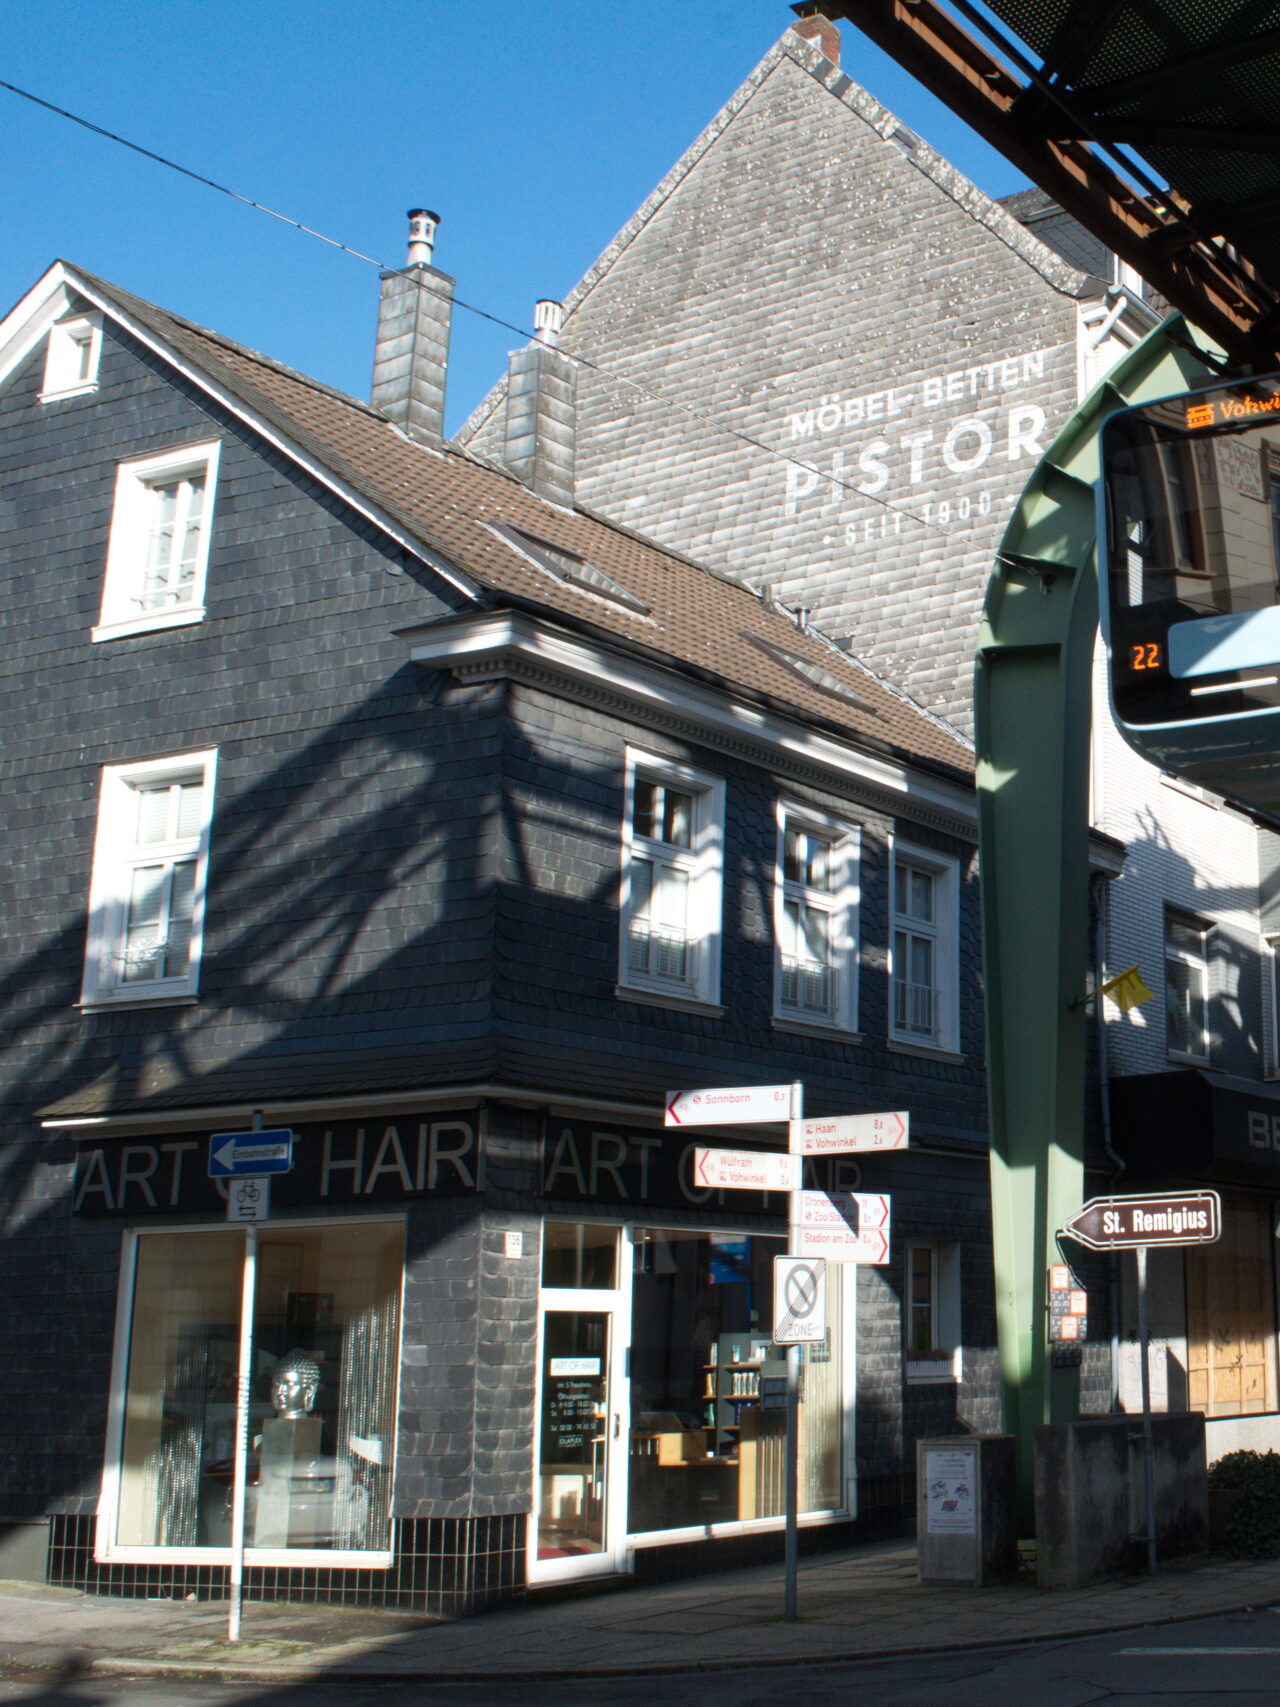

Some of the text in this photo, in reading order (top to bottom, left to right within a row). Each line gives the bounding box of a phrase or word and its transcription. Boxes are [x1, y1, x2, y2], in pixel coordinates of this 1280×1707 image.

[784, 404, 1046, 516] PISTOR
[845, 491, 992, 546] SEIT 1900
[1132, 643, 1160, 671] 22
[705, 1093, 751, 1104] Sonnborn
[815, 1124, 836, 1134] Haan
[816, 1136, 857, 1149] Vohwinkel
[75, 1141, 199, 1211] ART
[320, 1120, 476, 1197] HAIR
[544, 1128, 662, 1199] ART
[720, 1155, 752, 1168] Wülfrath
[729, 1172, 767, 1185] Vohwinkel
[805, 1196, 846, 1209] Cronenberg
[1103, 1206, 1208, 1235] St. Remigius
[804, 1233, 830, 1243] Stadion
[831, 1235, 843, 1243] am
[845, 1234, 858, 1244] Zoo
[788, 1322, 814, 1337] ZONE
